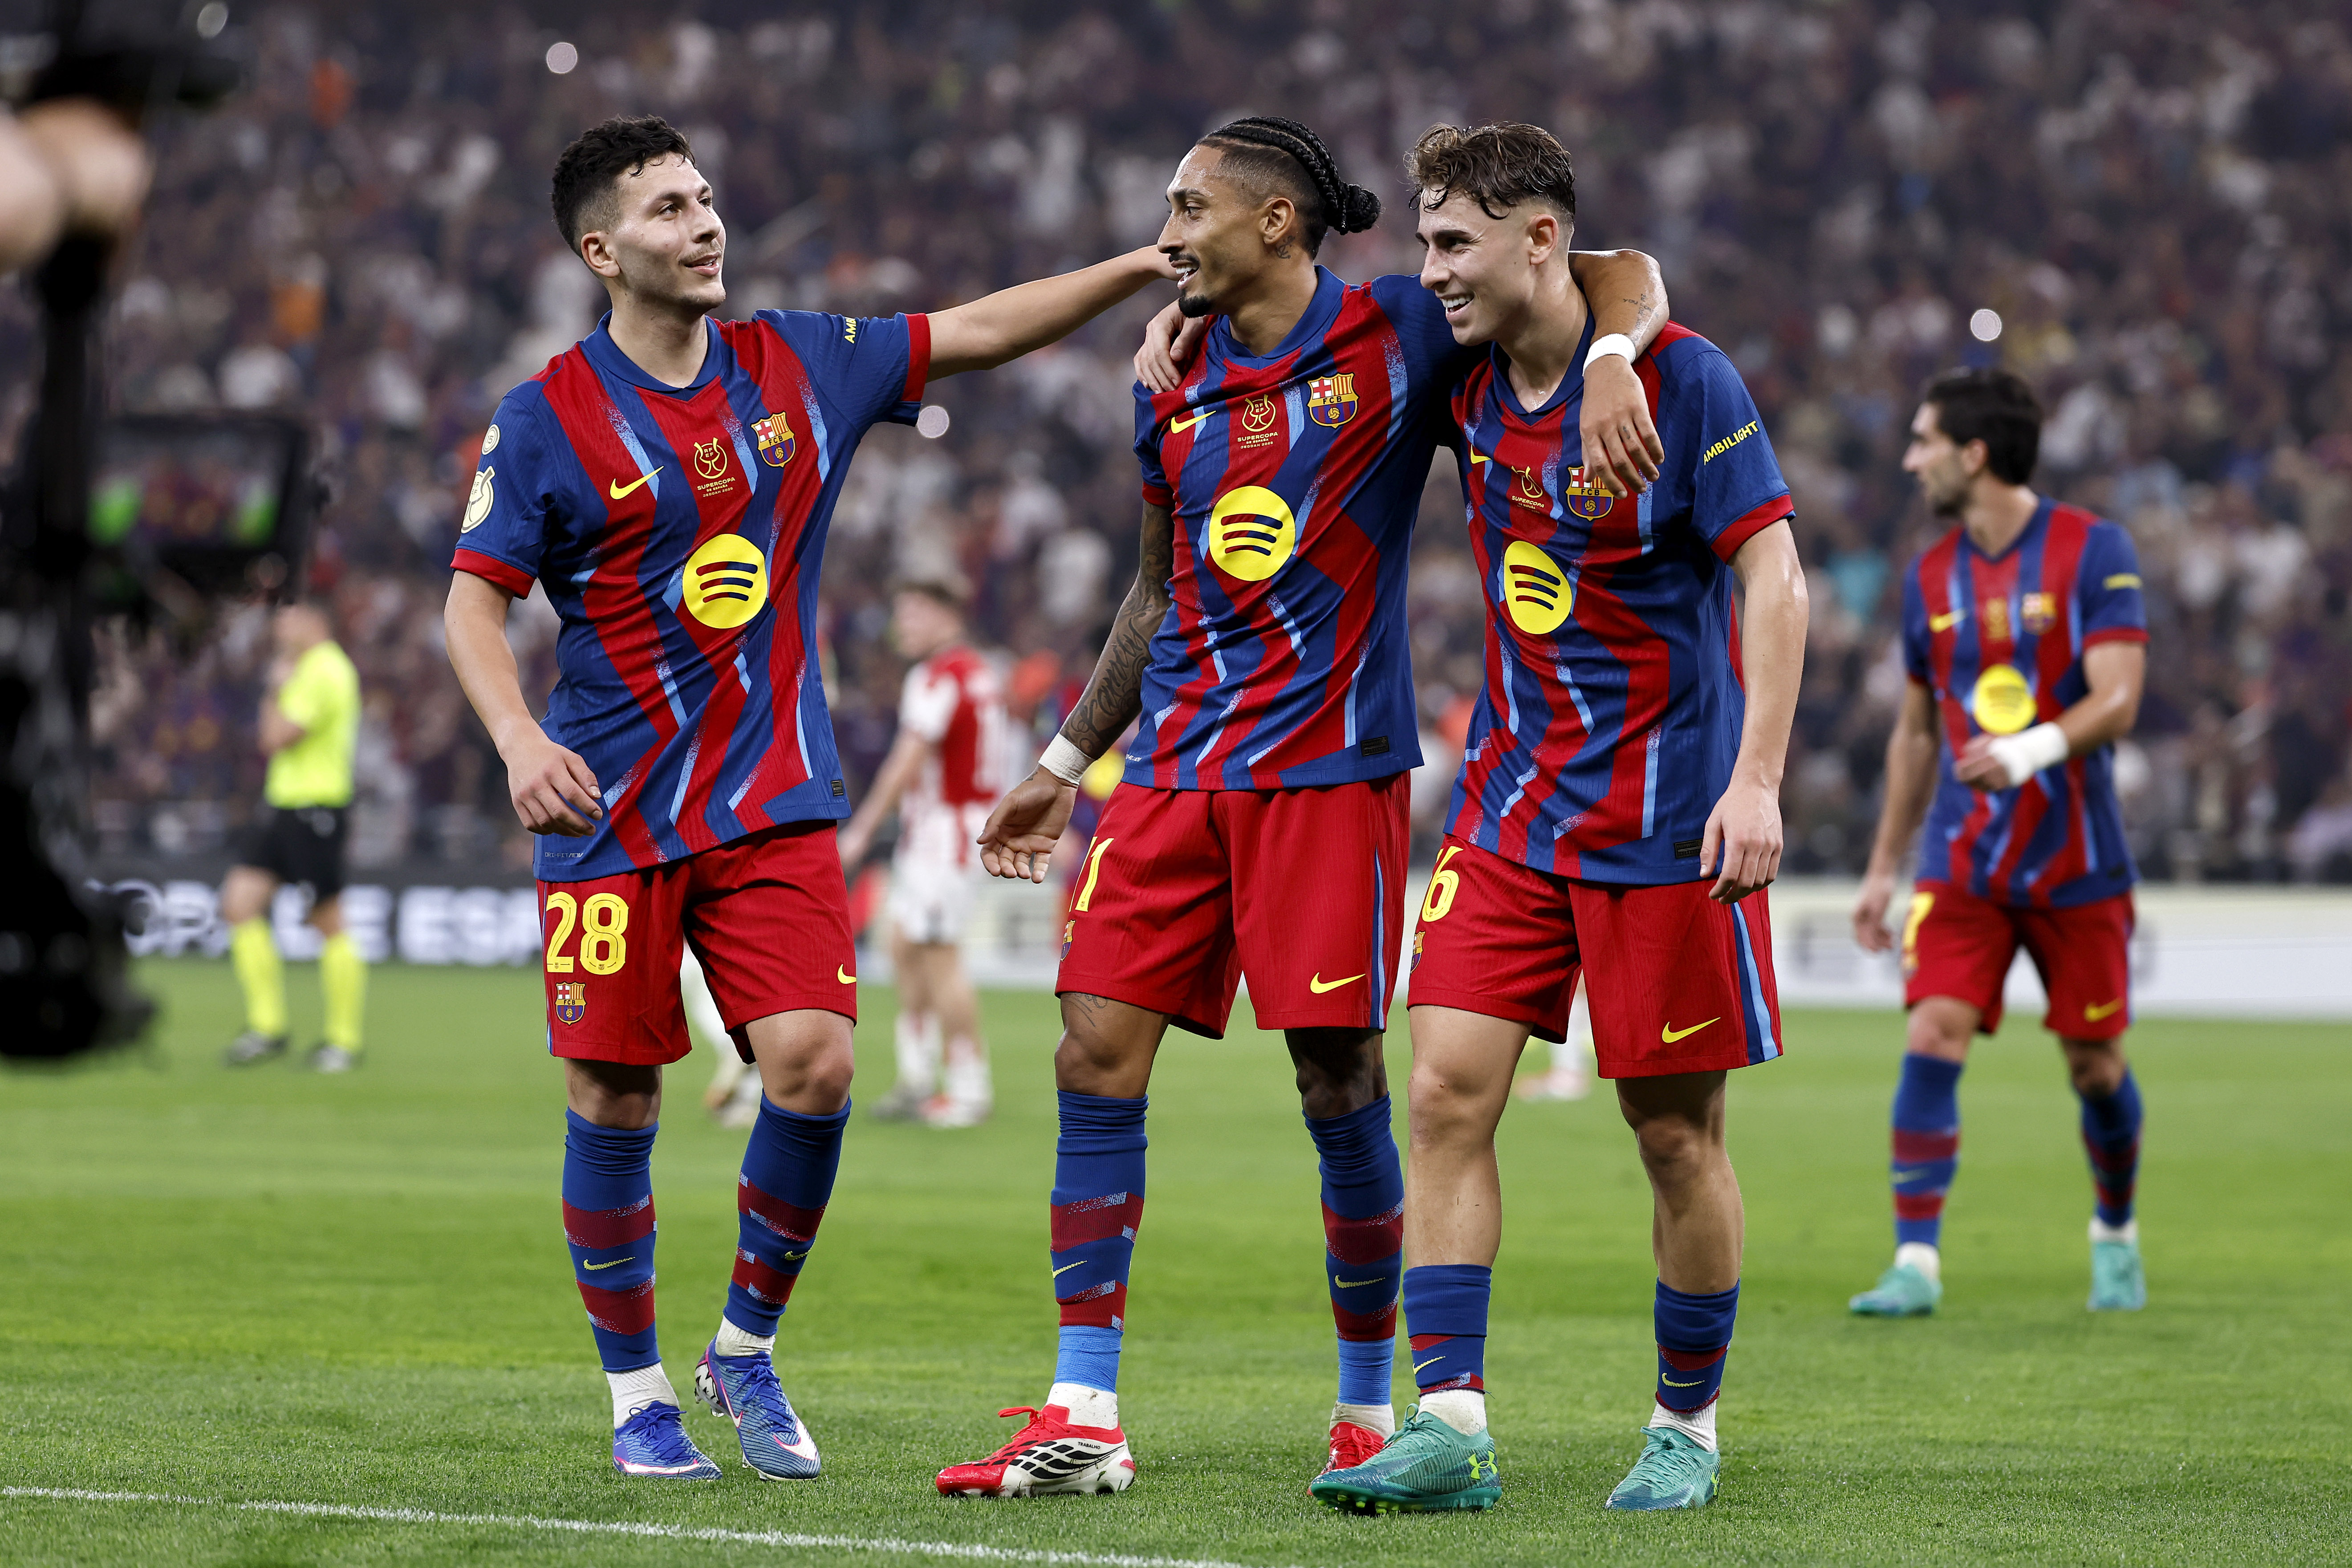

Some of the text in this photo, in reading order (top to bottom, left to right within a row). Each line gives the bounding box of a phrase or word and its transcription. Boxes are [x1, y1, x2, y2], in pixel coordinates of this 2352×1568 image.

[1323, 396, 1342, 404] FCB
[768, 435, 783, 446] FCB
[1237, 431, 1278, 442] SUPERCOPA
[1703, 420, 1759, 466] AMBILIGHT
[697, 477, 735, 490] SUPERCOPA
[1511, 496, 1545, 508] SUPERCOPA
[1422, 846, 1464, 922] 6
[546, 891, 629, 975] 28
[1078, 1442, 1101, 1450] TRABALHO
